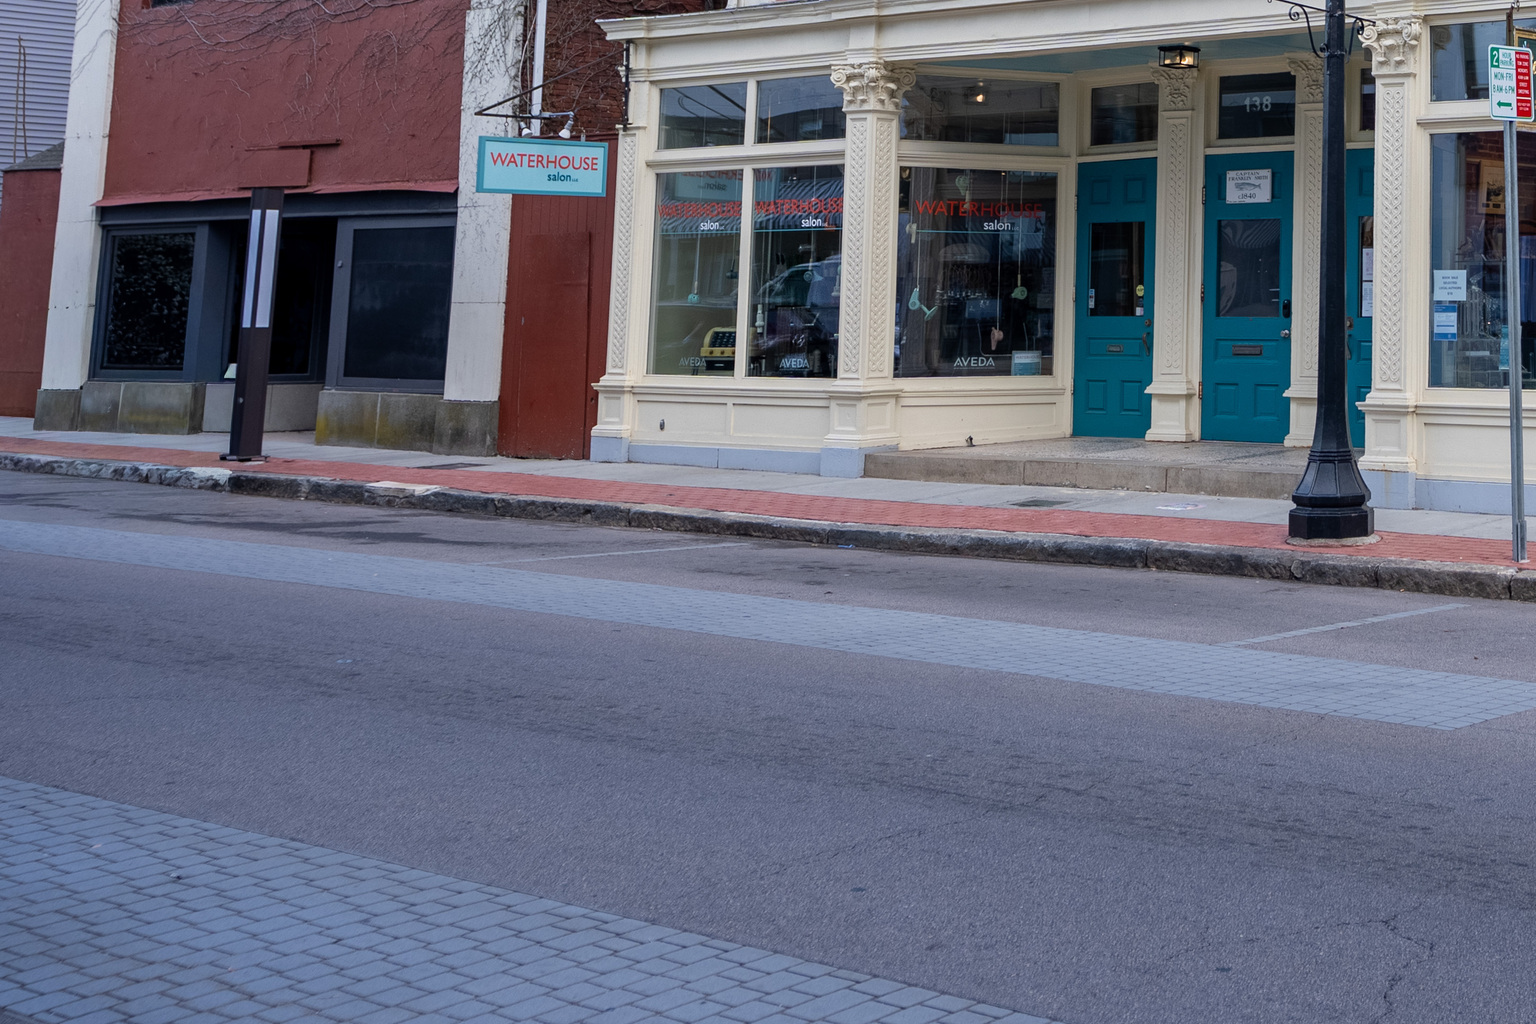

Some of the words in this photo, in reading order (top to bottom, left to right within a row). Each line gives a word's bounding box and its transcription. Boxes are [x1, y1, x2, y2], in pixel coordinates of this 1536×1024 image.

[1492, 50, 1499, 66] 2
[1244, 96, 1272, 112] 138
[490, 152, 599, 171] WATERHOUSE
[547, 171, 571, 182] salon
[657, 201, 741, 218] WATERHOUSE
[755, 197, 844, 215] WATERHOUSE
[915, 199, 1043, 219] WATERHOUSE
[700, 219, 719, 230] salon
[801, 216, 822, 227] salon
[983, 219, 1011, 231] salon
[678, 357, 707, 366] AVEDA
[779, 358, 810, 368] AVEDA
[953, 356, 995, 367] AVEDA
